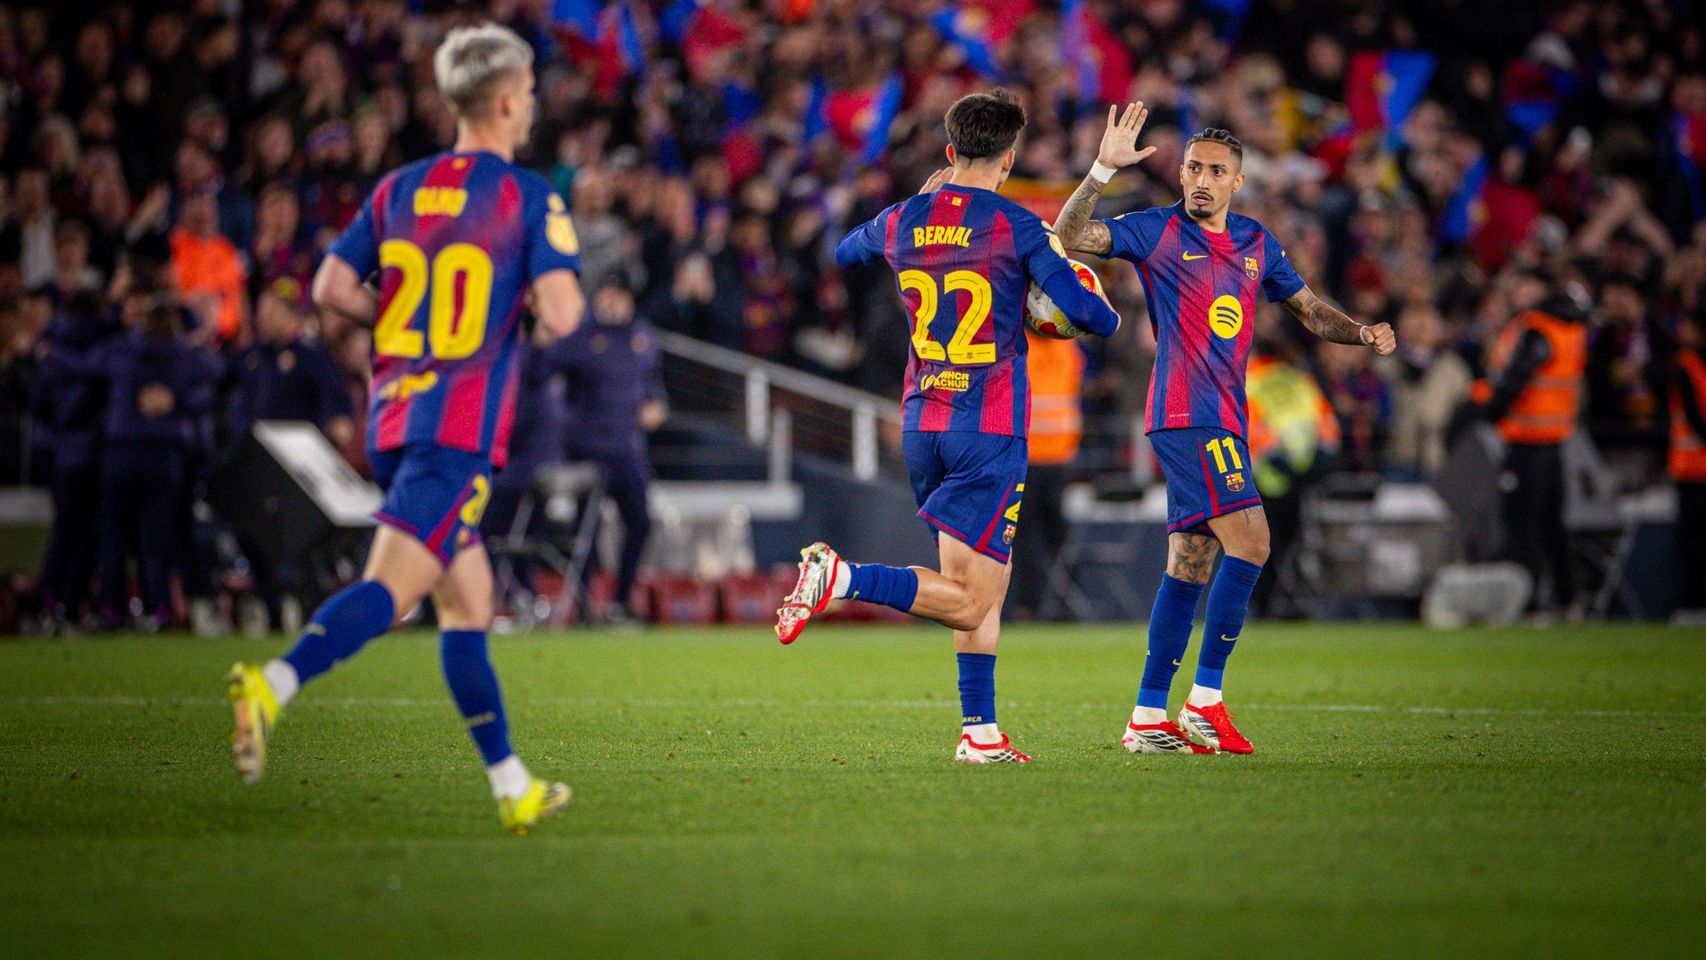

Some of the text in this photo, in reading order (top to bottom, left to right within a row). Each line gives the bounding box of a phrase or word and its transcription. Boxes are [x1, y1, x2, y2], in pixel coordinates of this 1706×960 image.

[913, 226, 973, 248] BERNAL
[374, 239, 493, 360] 20
[898, 269, 996, 365] 22
[1205, 436, 1243, 474] 11
